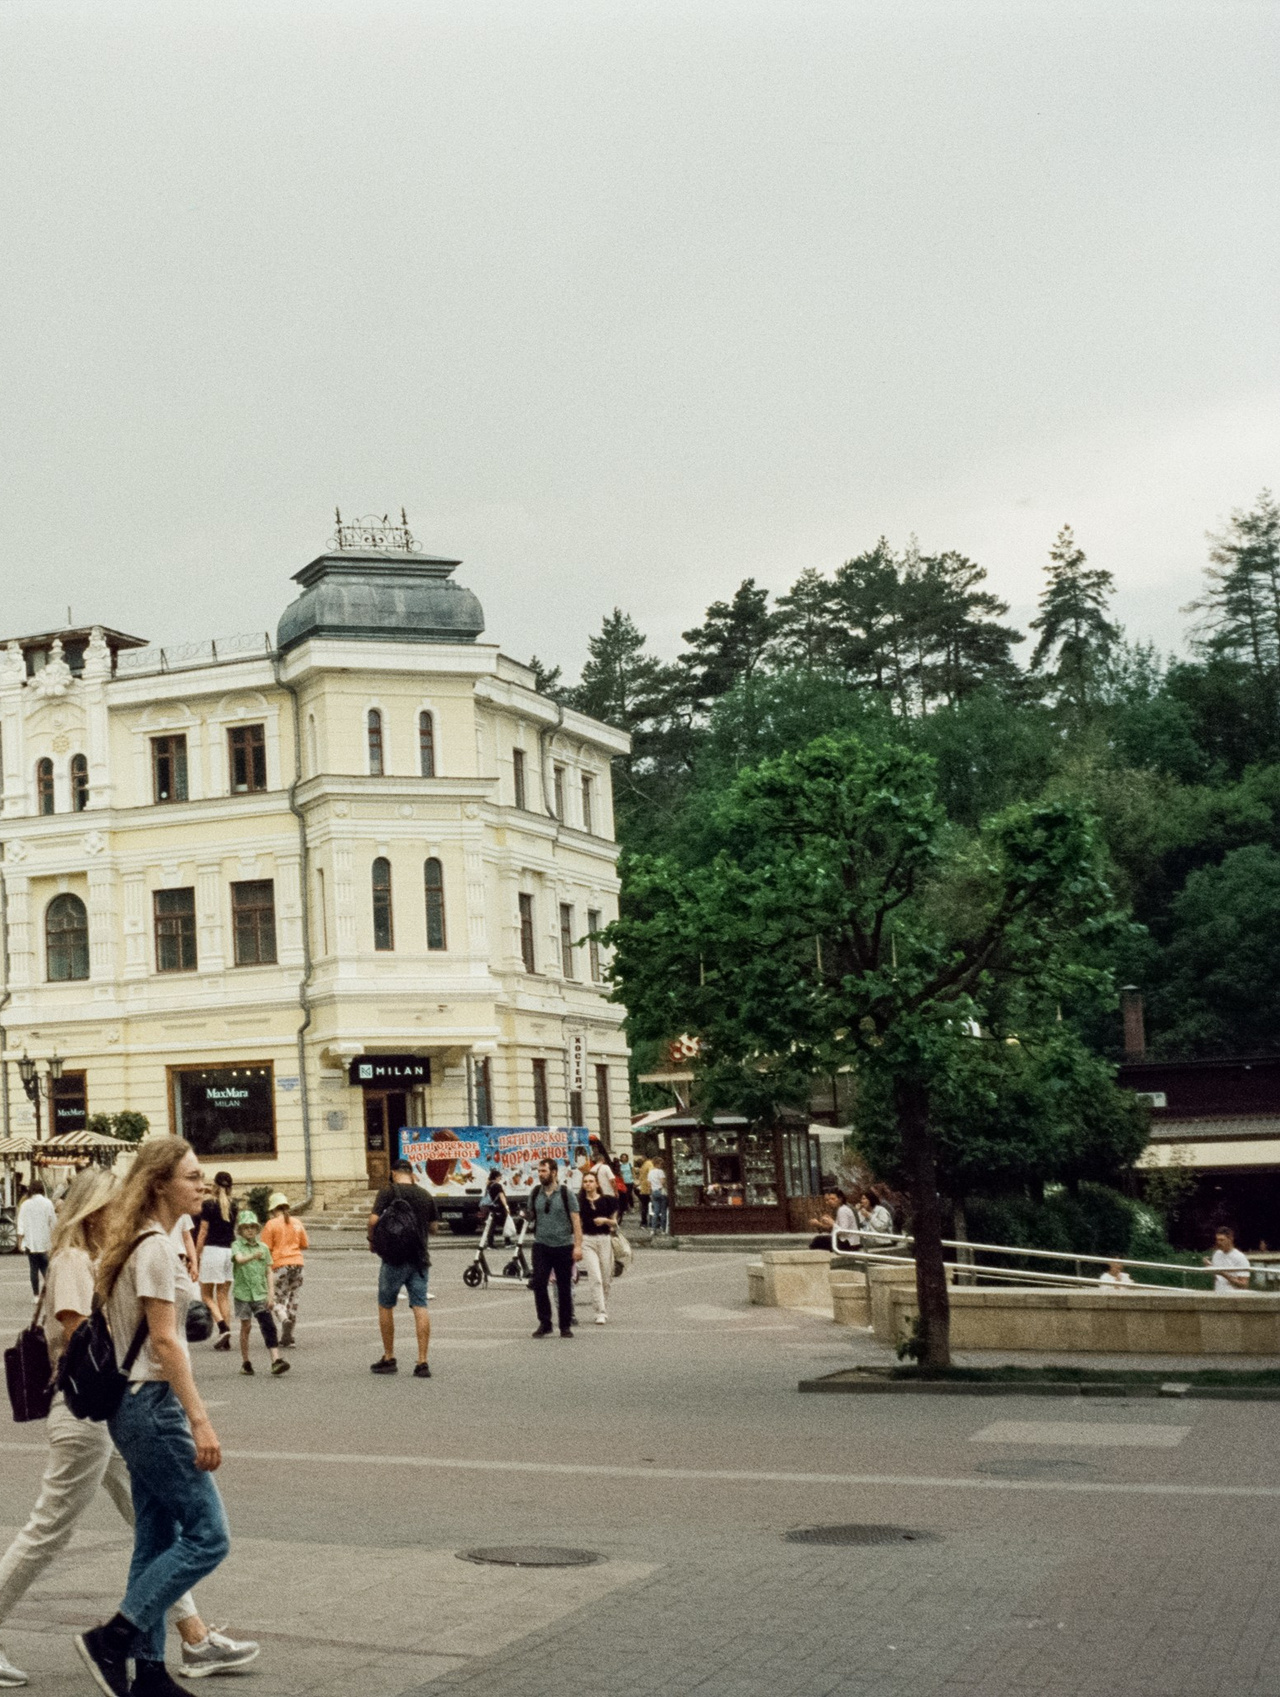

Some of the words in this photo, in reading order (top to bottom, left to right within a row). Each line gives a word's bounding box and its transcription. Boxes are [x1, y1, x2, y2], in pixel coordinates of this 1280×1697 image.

[574, 1037, 582, 1084] ХОСТЕЛ
[375, 1067, 424, 1075] MILAN
[206, 1088, 249, 1099] MaxMara
[57, 1108, 86, 1117] MaxMara
[408, 1150, 477, 1162] МОРОЖЕНОЕ
[501, 1146, 569, 1168] МОРОЖЕНОЕ
